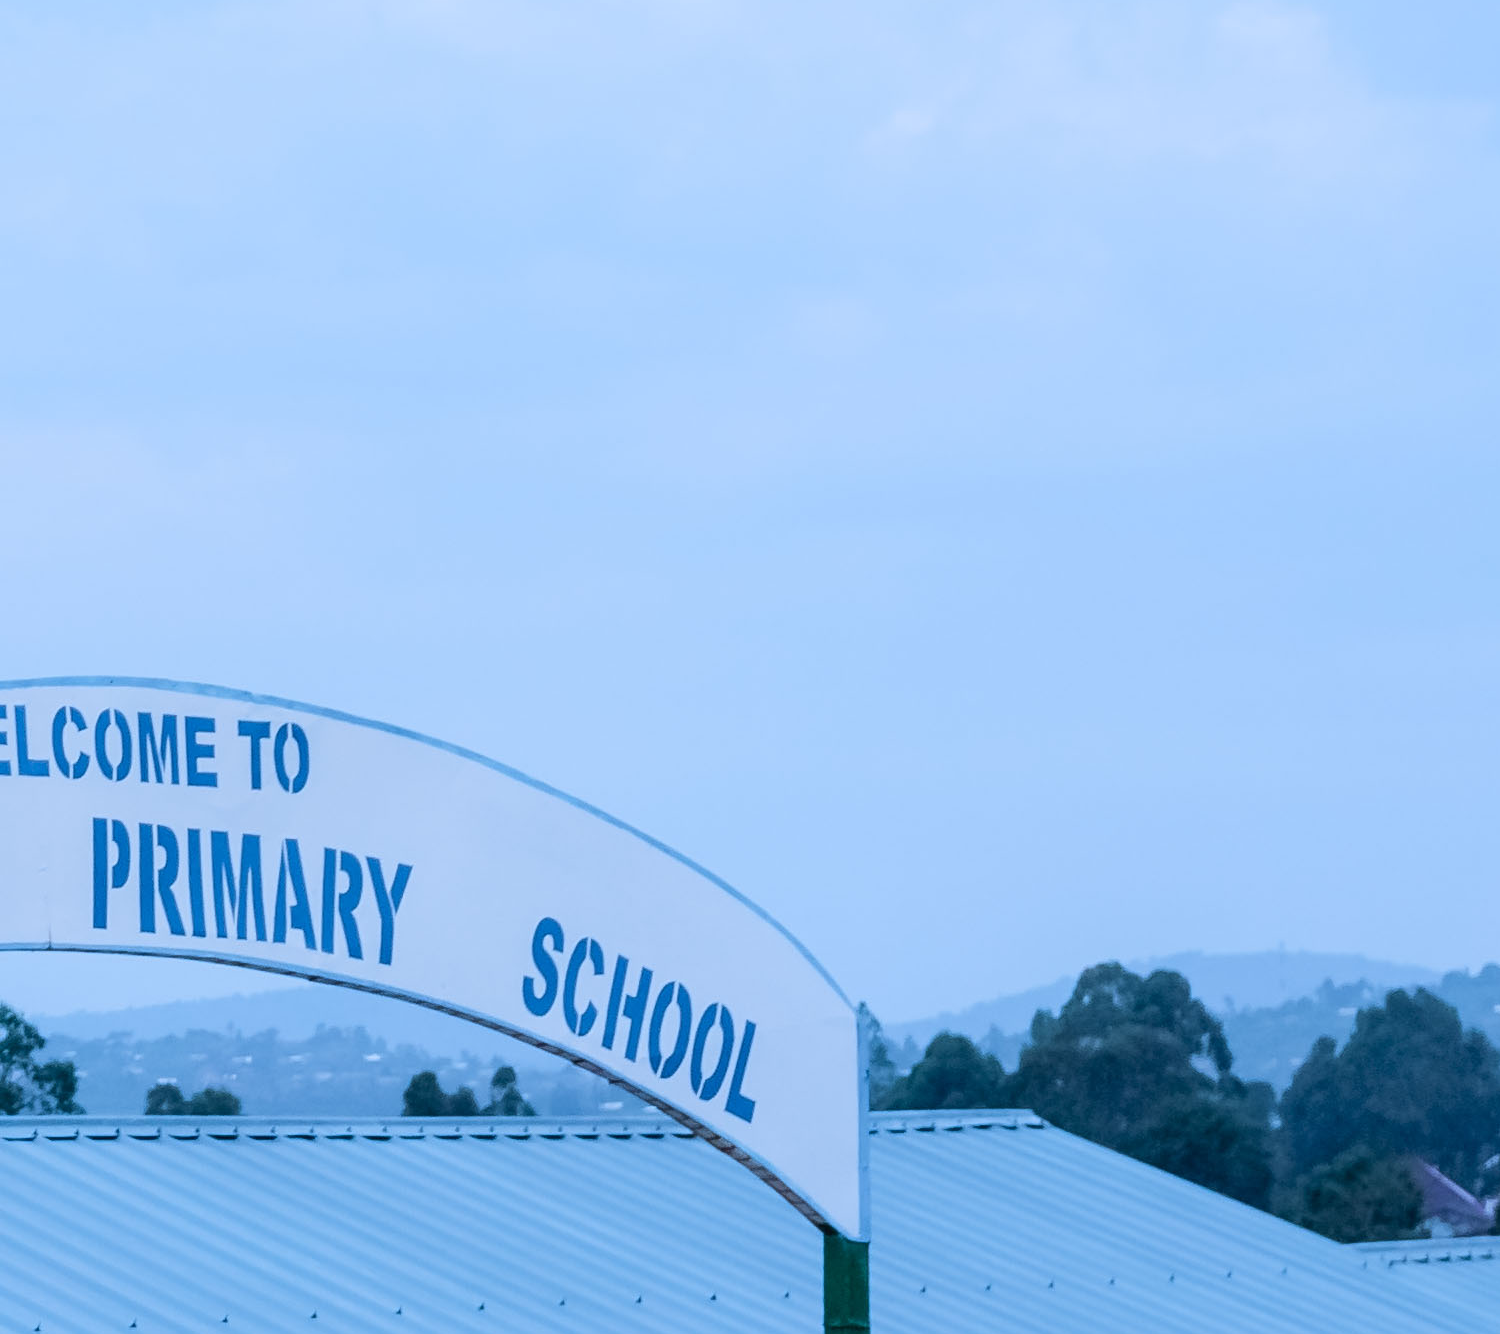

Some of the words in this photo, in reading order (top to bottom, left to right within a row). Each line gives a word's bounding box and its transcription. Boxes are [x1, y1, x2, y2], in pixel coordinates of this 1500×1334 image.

[237, 719, 310, 795] TO
[92, 817, 413, 967] PRIMARY
[521, 916, 757, 1124] SCHOOL
